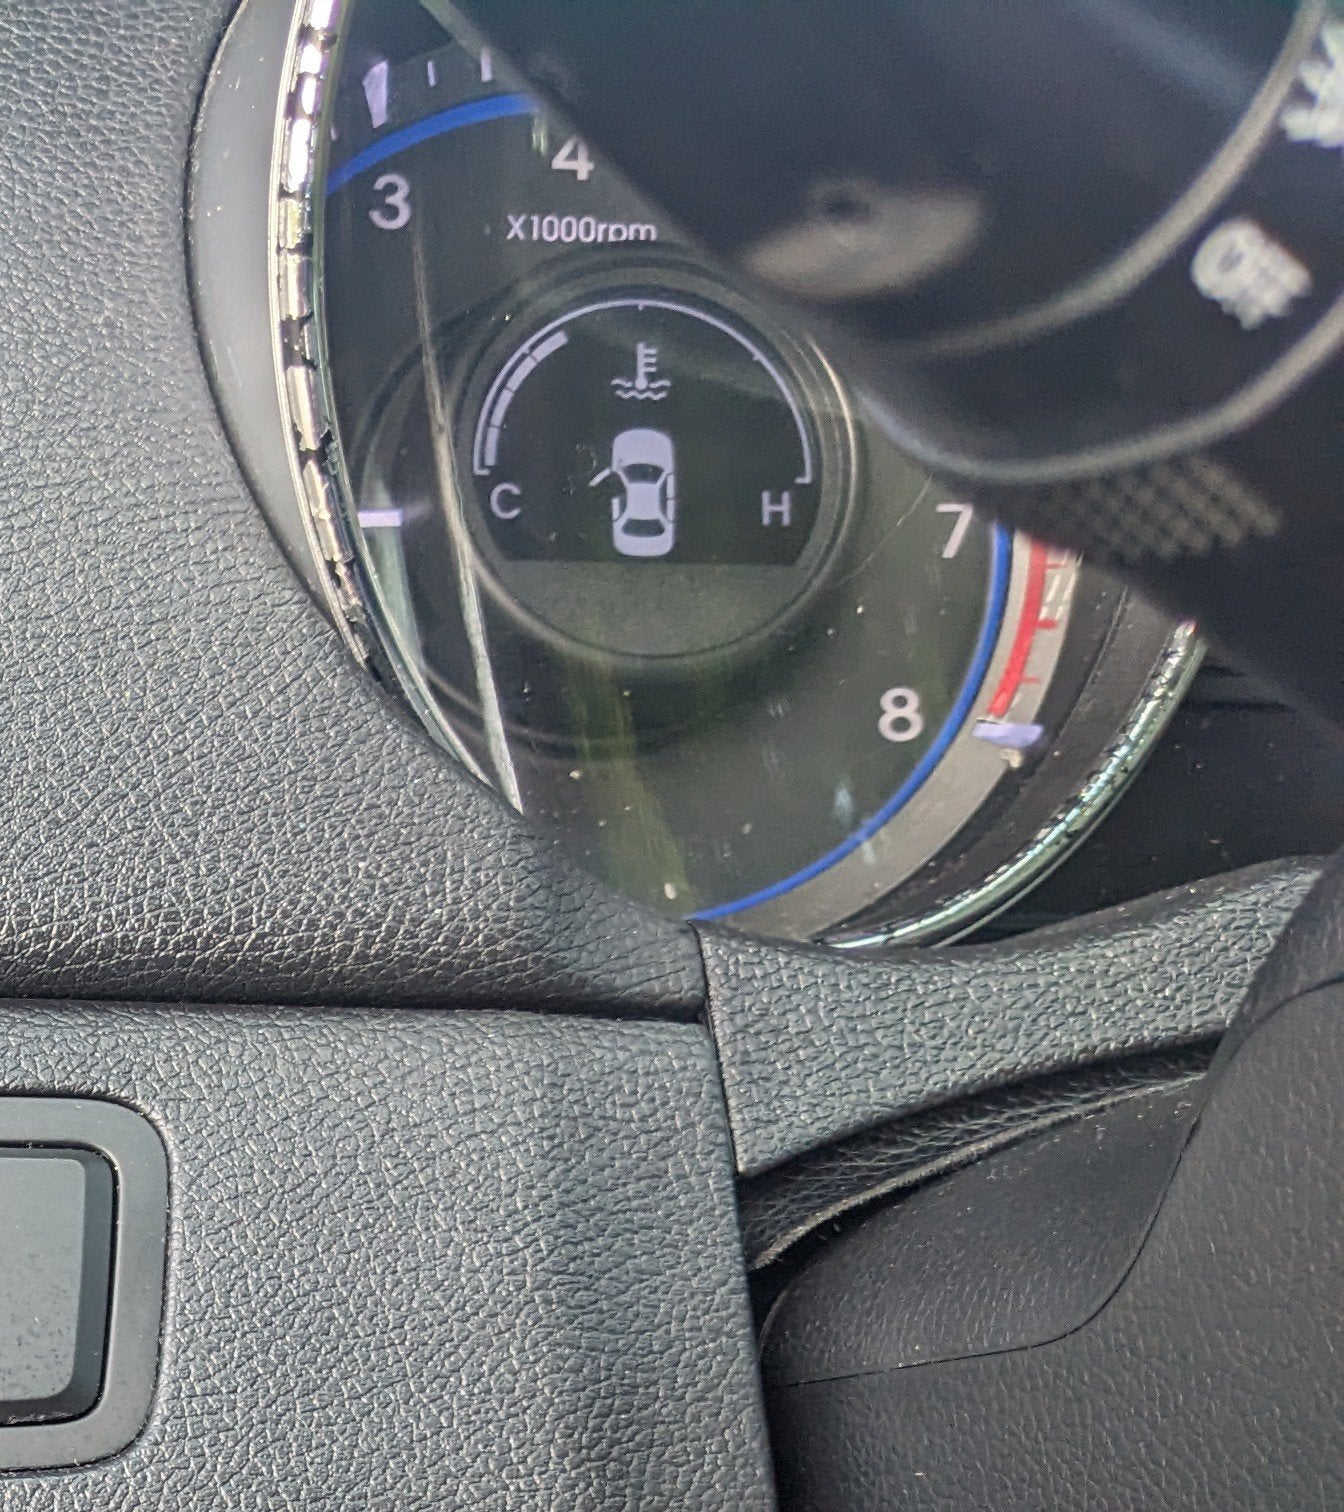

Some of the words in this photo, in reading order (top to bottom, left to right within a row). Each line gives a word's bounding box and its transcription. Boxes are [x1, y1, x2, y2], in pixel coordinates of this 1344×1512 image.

[550, 134, 595, 181] 4
[368, 172, 412, 230] 3
[506, 214, 658, 243] X1000rpm
[489, 483, 522, 520] C
[760, 490, 792, 526] H
[935, 501, 974, 558] 7
[877, 687, 924, 742] 8
